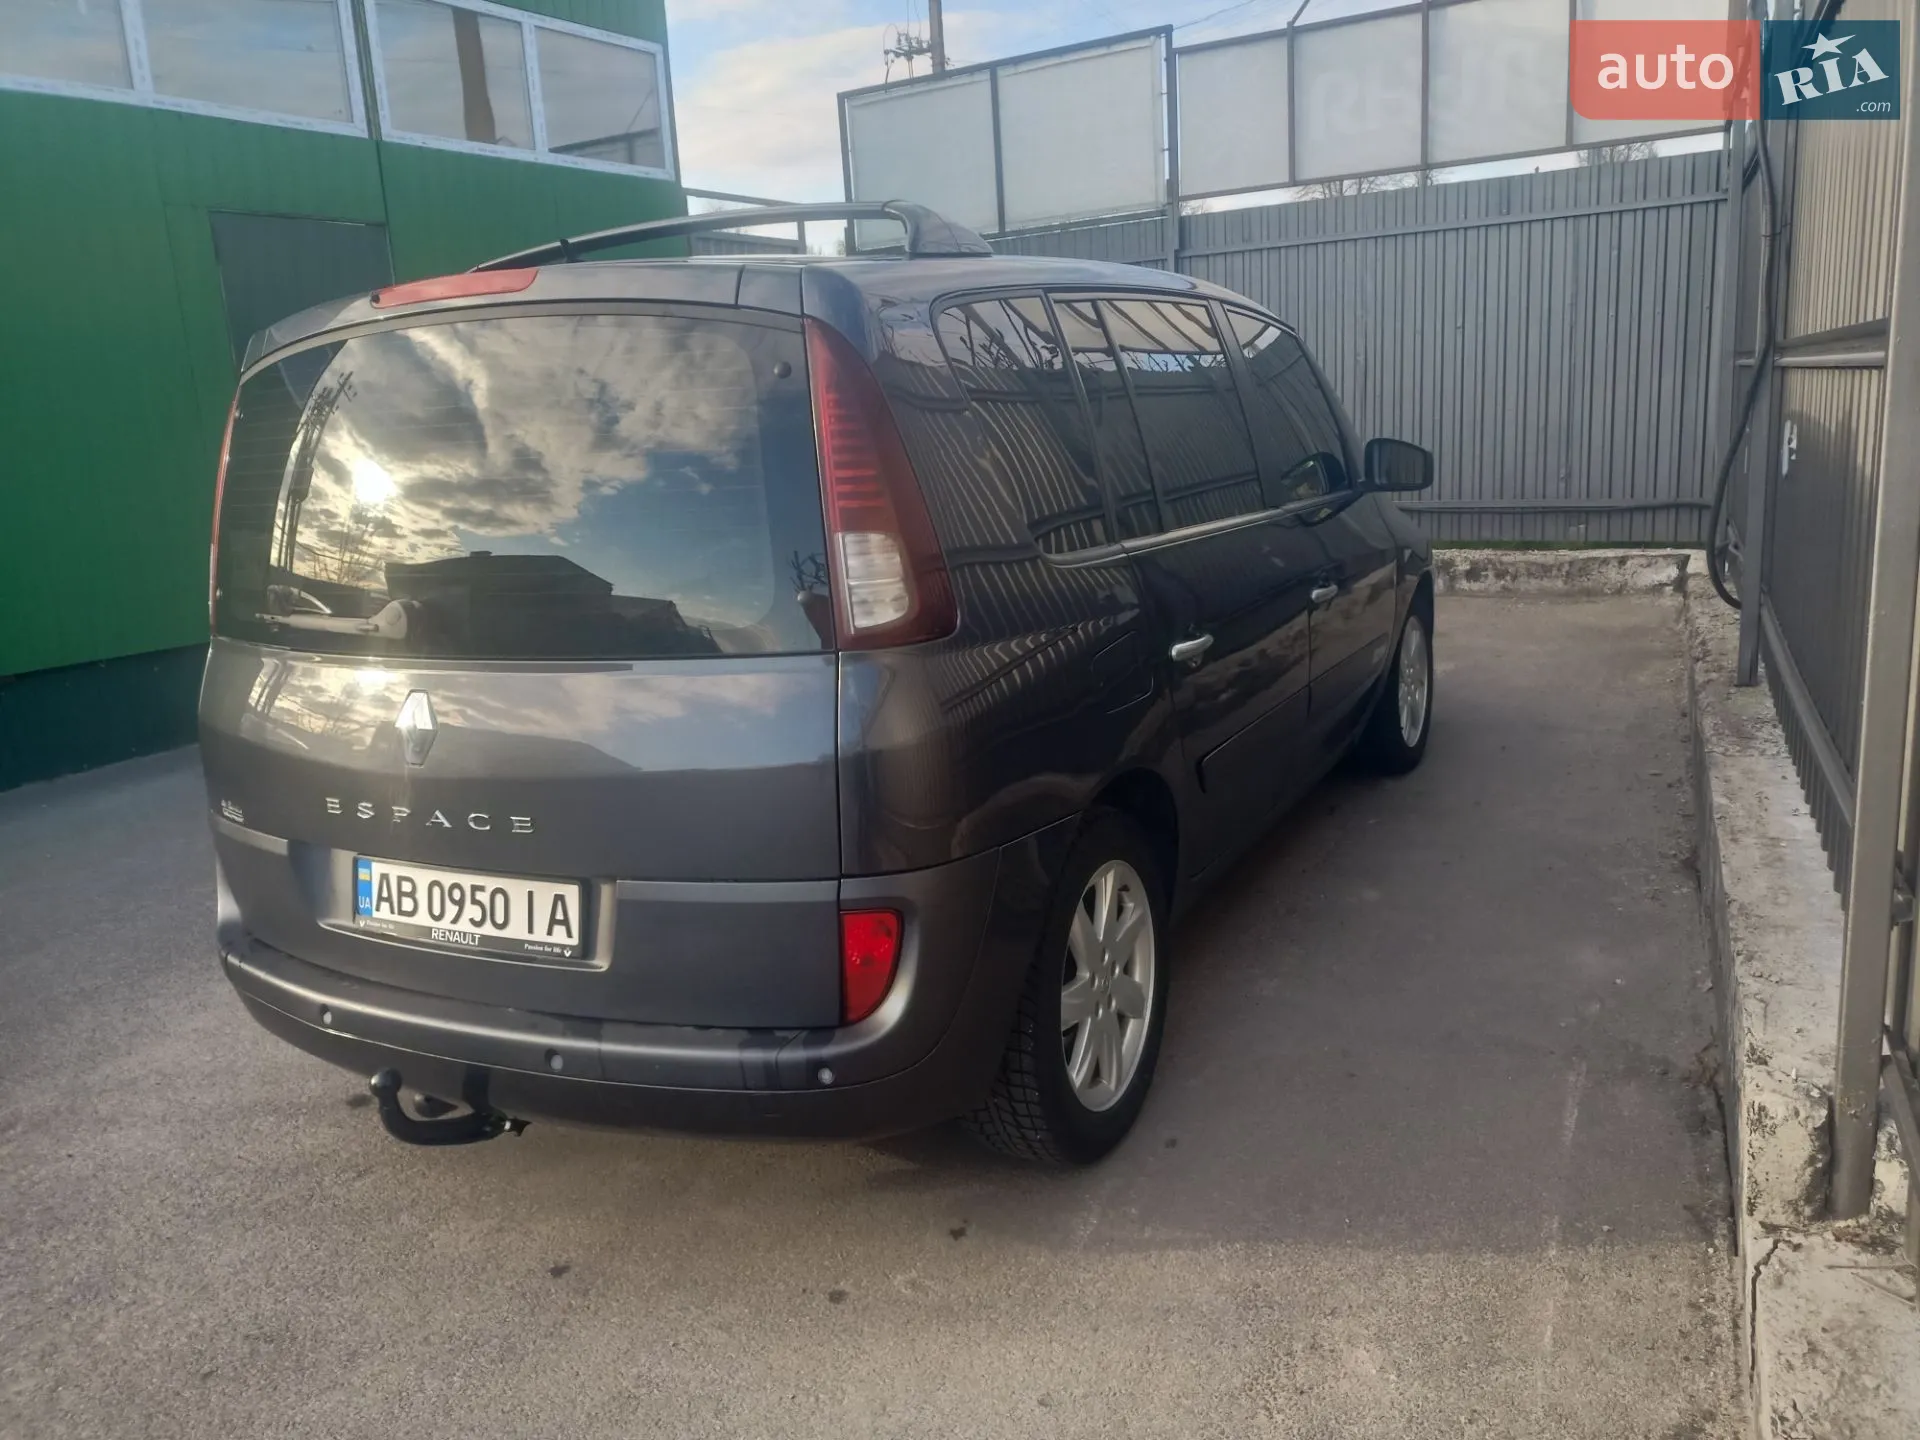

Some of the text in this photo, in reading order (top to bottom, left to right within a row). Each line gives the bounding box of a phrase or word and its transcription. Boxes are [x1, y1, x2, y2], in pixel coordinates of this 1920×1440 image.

[325, 797, 535, 833] ESPACE
[358, 896, 371, 909] UA
[375, 873, 573, 938] AB 0950 IA
[431, 928, 481, 946] RENAULT
